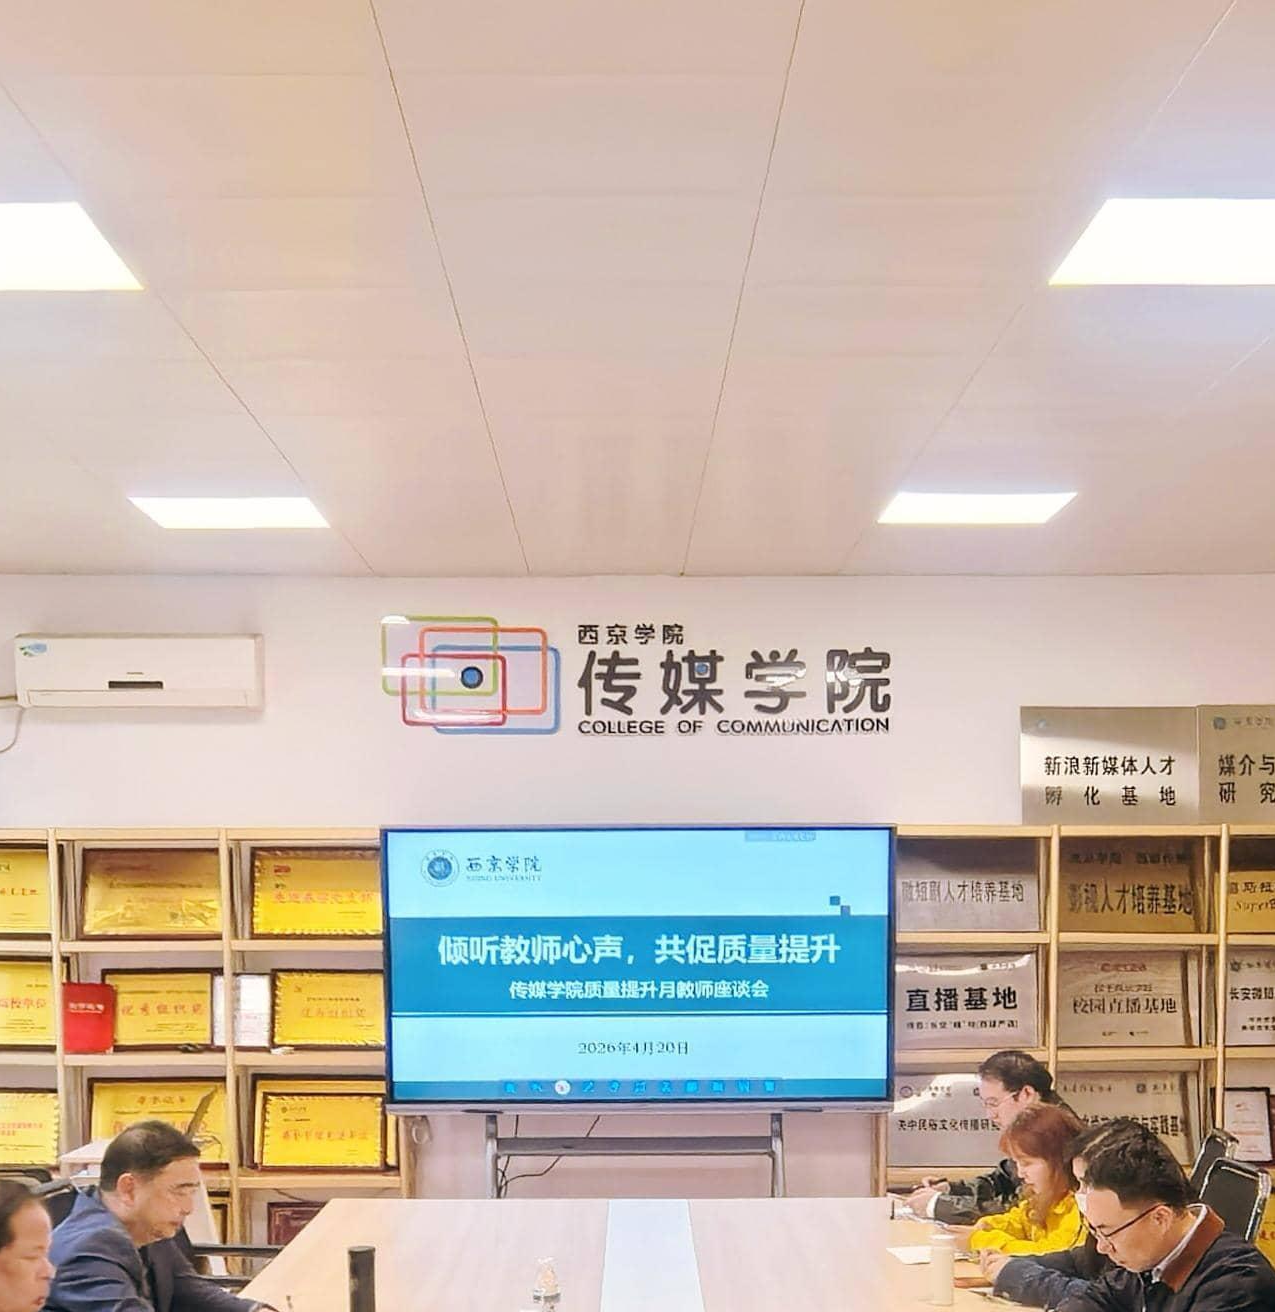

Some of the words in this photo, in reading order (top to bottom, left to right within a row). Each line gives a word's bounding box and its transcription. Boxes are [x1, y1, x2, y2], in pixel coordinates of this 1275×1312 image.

[577, 623, 685, 645] 西京学院
[577, 647, 892, 716] 传媒学院
[577, 720, 666, 734] COLLEGE
[678, 719, 704, 734] OF
[716, 717, 890, 734] COMMUNICATION
[1044, 755, 1176, 776] 新浪新媒体人才
[1044, 786, 1177, 806] 孵化基地
[467, 855, 542, 872] 西京学院
[438, 934, 841, 966] 倾听教师心声，共促质量提升
[508, 979, 769, 1000] 传媒学院质量提升月教师座谈会
[906, 986, 1019, 1012] 直播基地
[578, 1041, 689, 1056] 2026年4月20日
